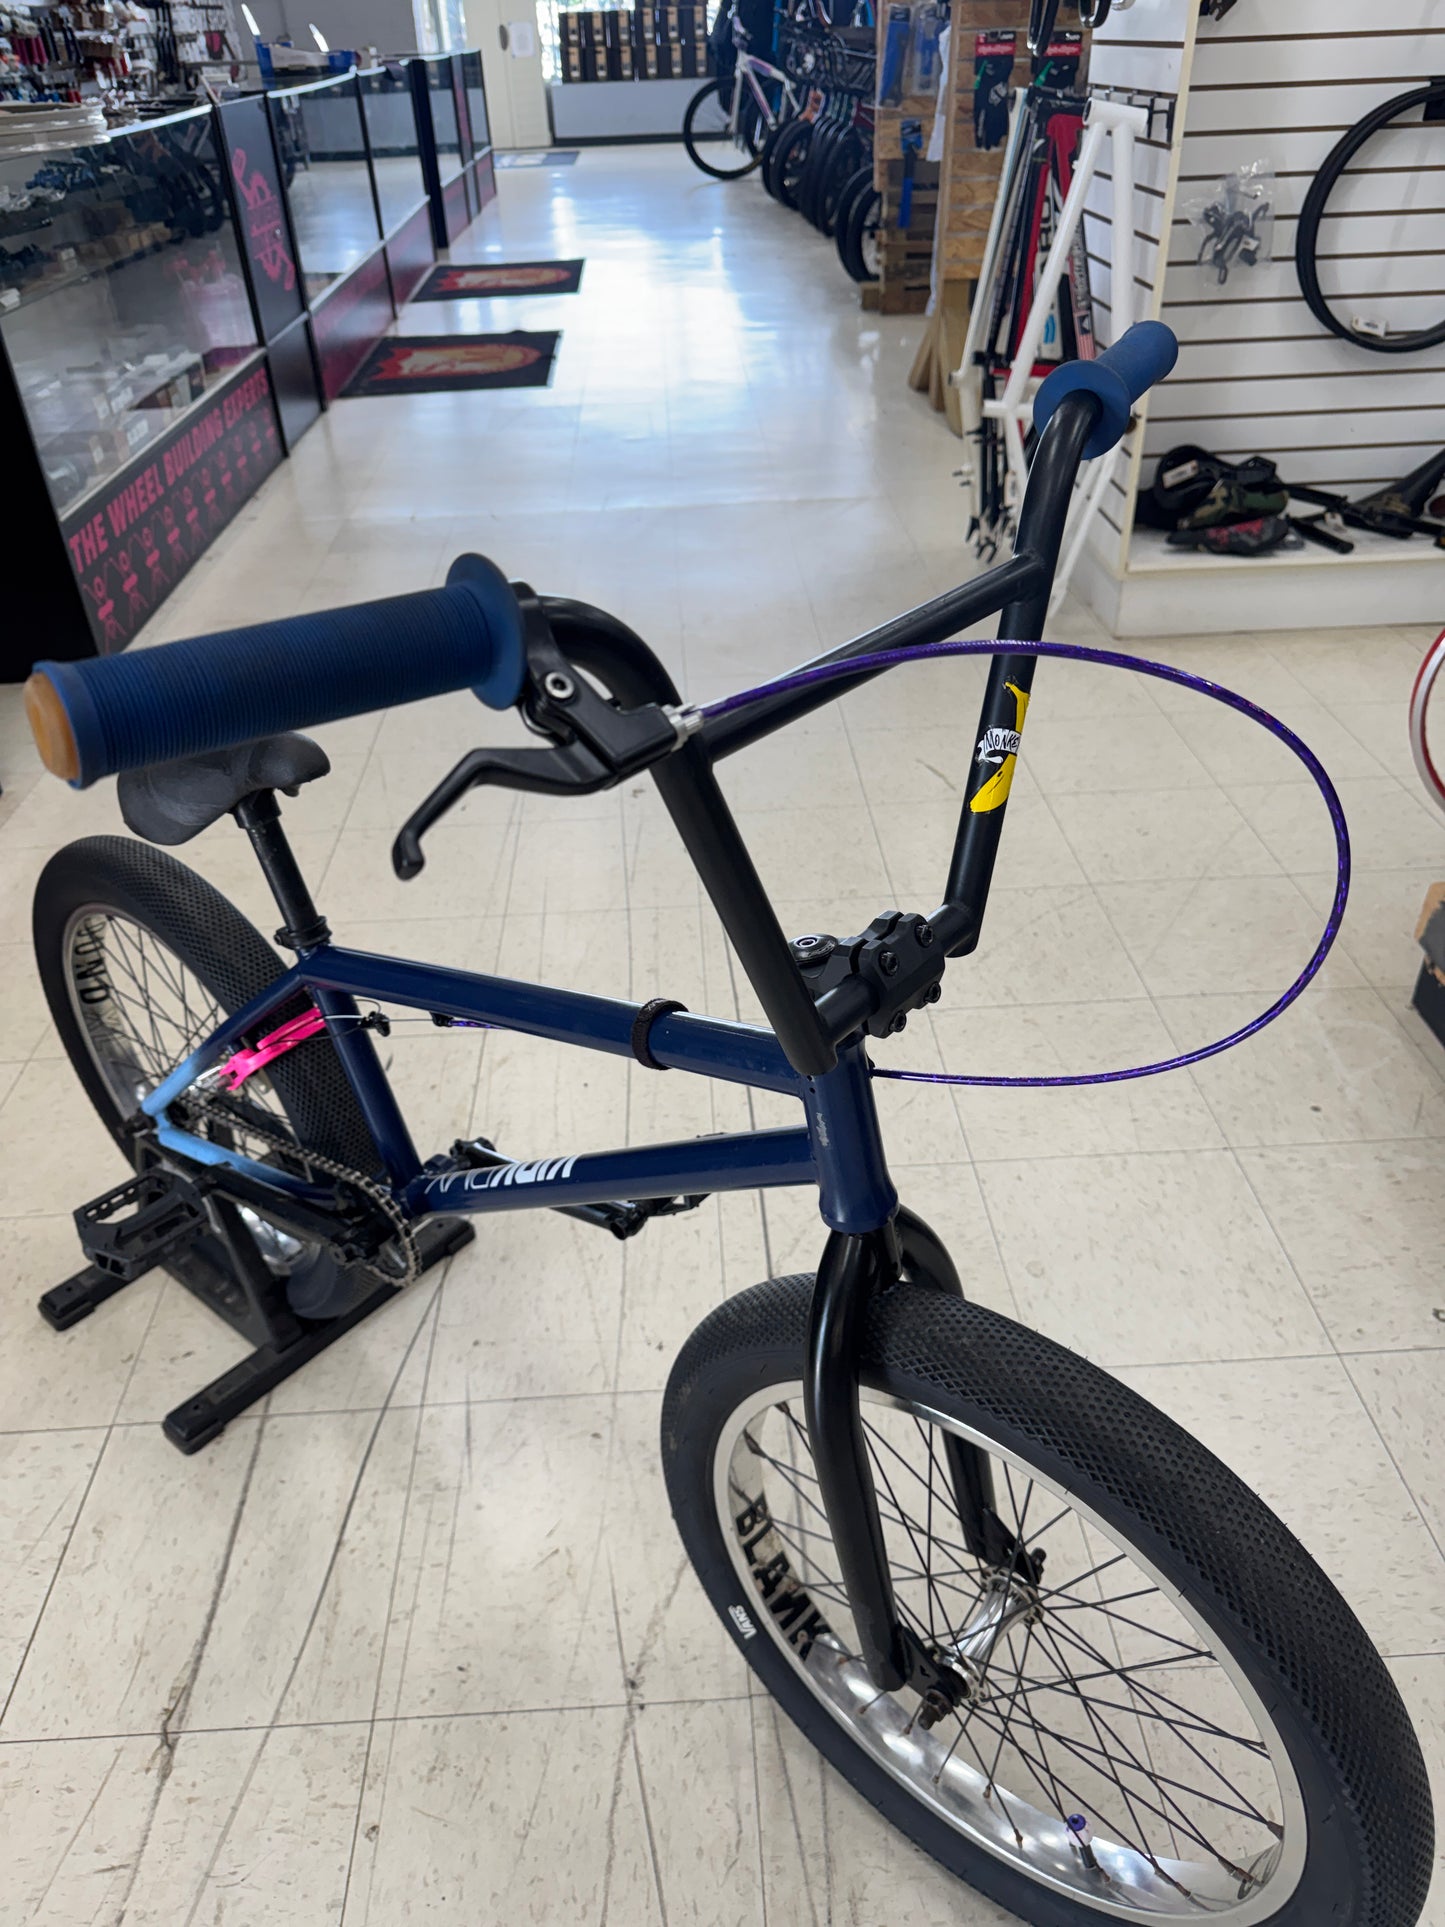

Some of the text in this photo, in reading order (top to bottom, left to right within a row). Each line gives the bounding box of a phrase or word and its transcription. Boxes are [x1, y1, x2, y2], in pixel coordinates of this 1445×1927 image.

[69, 513, 109, 574] THE
[106, 463, 164, 538] WHEEL
[163, 408, 224, 487] BUILDING
[728, 1604, 757, 1640] VANS
[735, 1491, 832, 1662] BLANK
